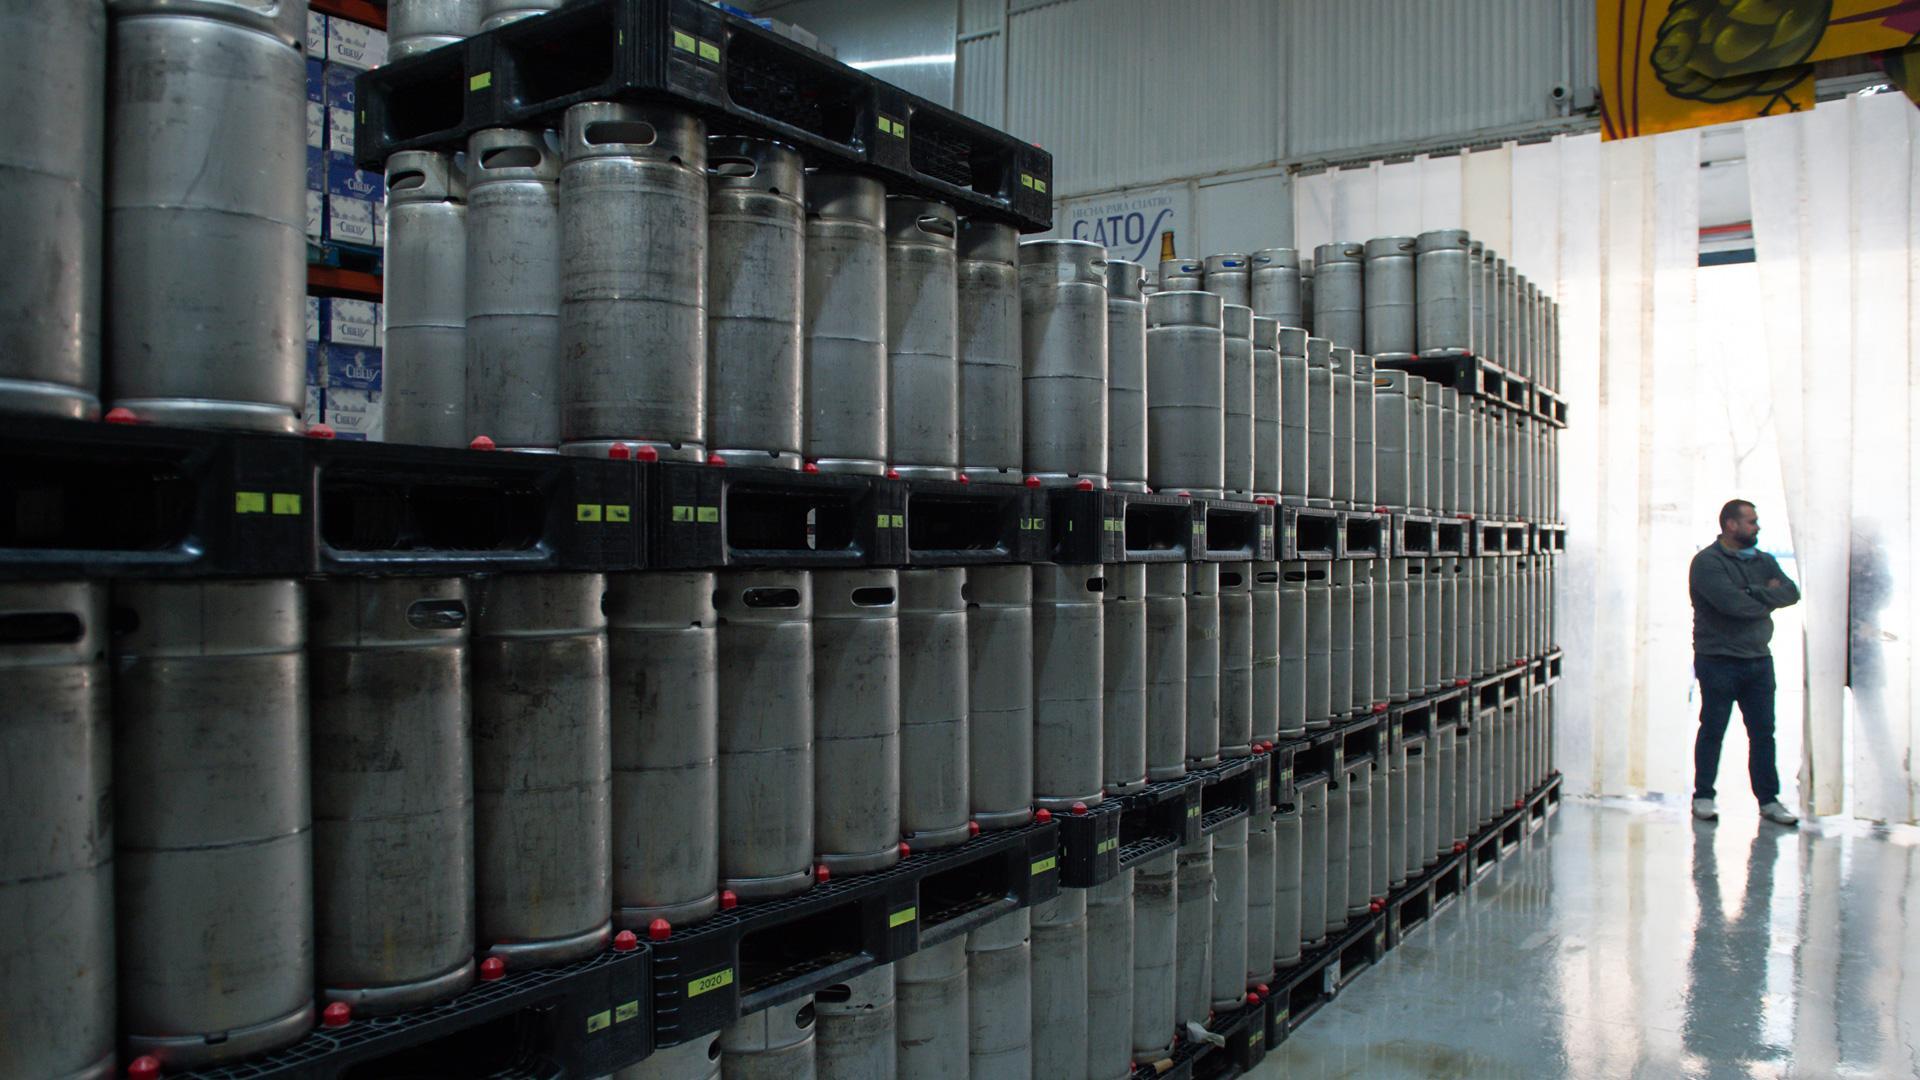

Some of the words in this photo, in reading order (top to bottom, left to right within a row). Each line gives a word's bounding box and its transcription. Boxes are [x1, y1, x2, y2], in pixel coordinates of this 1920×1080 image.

[1073, 207, 1104, 218] HECHA
[1107, 202, 1129, 213] PARA
[1131, 197, 1172, 210] CUATRO
[699, 975, 722, 990] 2020
